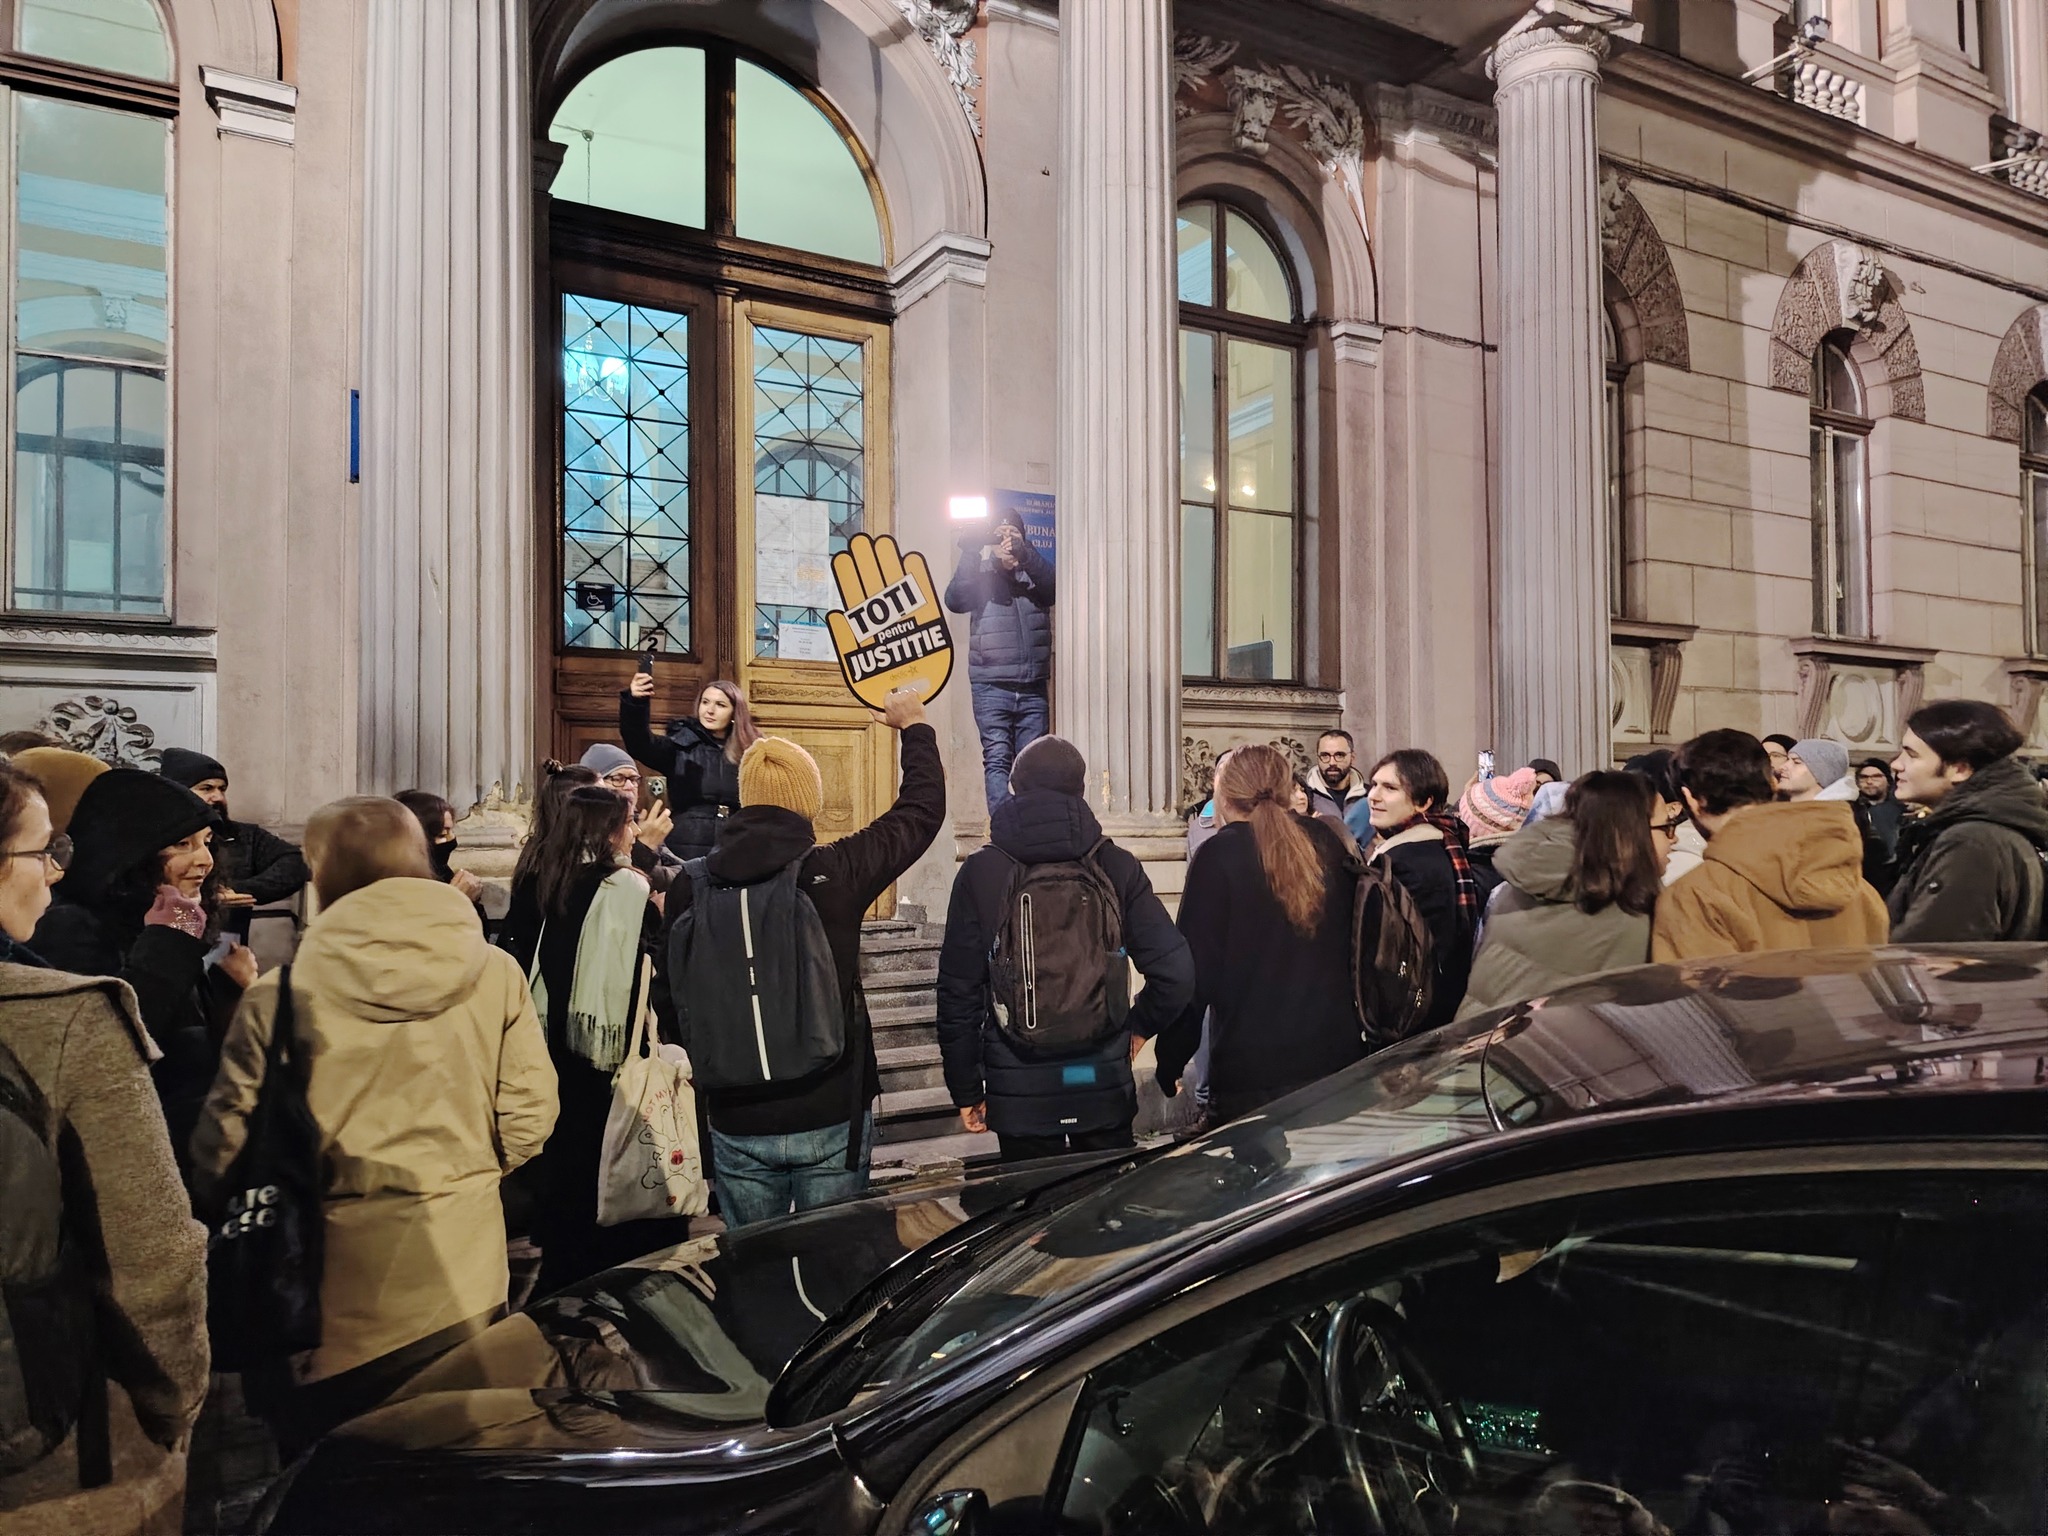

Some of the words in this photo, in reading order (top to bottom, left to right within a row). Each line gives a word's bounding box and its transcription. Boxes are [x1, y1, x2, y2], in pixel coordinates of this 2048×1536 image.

[848, 581, 918, 634] TOȚI
[647, 637, 658, 652] 2
[877, 620, 915, 644] pentru
[850, 625, 947, 681] JUSTIȚIE
